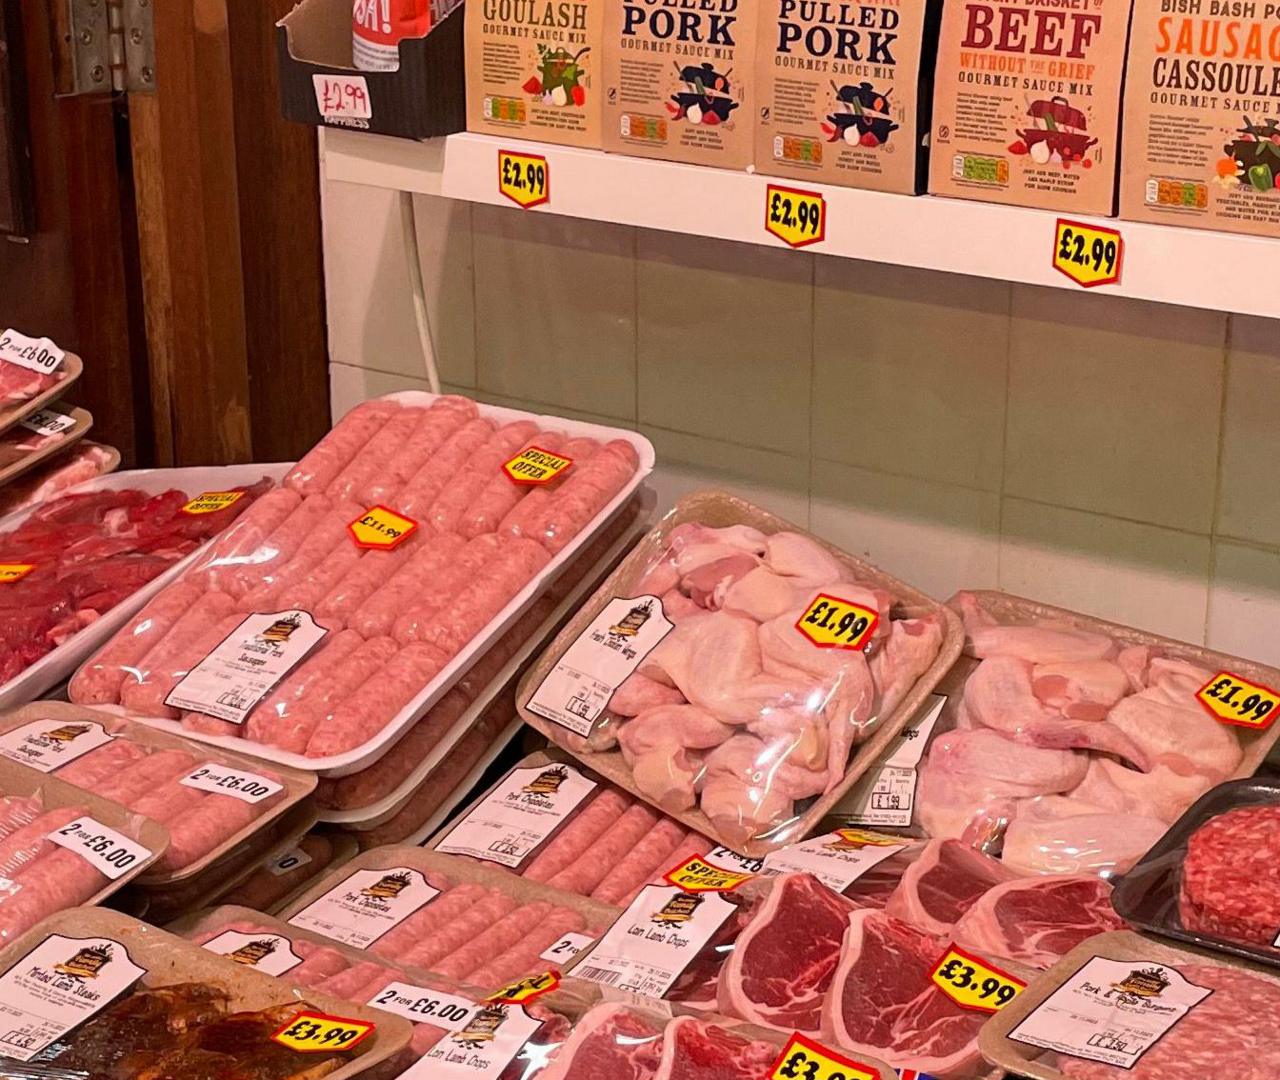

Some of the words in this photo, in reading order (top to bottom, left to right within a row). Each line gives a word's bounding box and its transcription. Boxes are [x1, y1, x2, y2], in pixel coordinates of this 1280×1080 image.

[483, 0, 588, 30] GOULASH
[779, 0, 901, 31] PULLED
[1160, 0, 1206, 16] BISH
[1210, 1, 1258, 19] BASH
[483, 24, 530, 40] GOURMET
[532, 28, 564, 42] SAUCE
[570, 33, 586, 44] MIX
[623, 6, 738, 46] PORK
[961, 5, 1102, 59] BEEF
[621, 38, 673, 54] GOURMET
[675, 43, 710, 58] SAUCE
[714, 47, 734, 60] MIX
[777, 22, 898, 65] PORK
[775, 55, 828, 73] GOURMET
[832, 60, 869, 77] SAUCE
[873, 66, 895, 80] MIX
[959, 52, 1026, 74] WITHOUT
[1030, 59, 1046, 74] THE
[1047, 60, 1096, 81] GRIEF
[323, 80, 367, 113] £2.99
[958, 70, 1017, 91] GOURMET
[1022, 76, 1065, 94] SAUCE
[1069, 82, 1093, 97] MIX
[1149, 91, 1218, 110] GOURMET
[1223, 98, 1271, 115] SAUCE
[502, 157, 545, 194] £2.99
[770, 193, 820, 235] £2.99
[1058, 227, 1117, 276] £2.99
[512, 461, 547, 479] OFFER
[521, 450, 565, 470] SPECIAL
[359, 516, 402, 538] £11.99
[805, 601, 868, 640] £1.99
[1206, 679, 1274, 720] £1.99
[190, 769, 210, 780] 2
[217, 774, 269, 797] £6.00
[58, 823, 80, 836] 2
[75, 830, 92, 840] FOR
[83, 835, 136, 868] £6.00
[938, 959, 1016, 1006] £3.99
[377, 990, 397, 1004] 2
[395, 995, 412, 1006] FOR
[410, 998, 469, 1022] £6.00
[284, 1020, 358, 1046] £3.99
